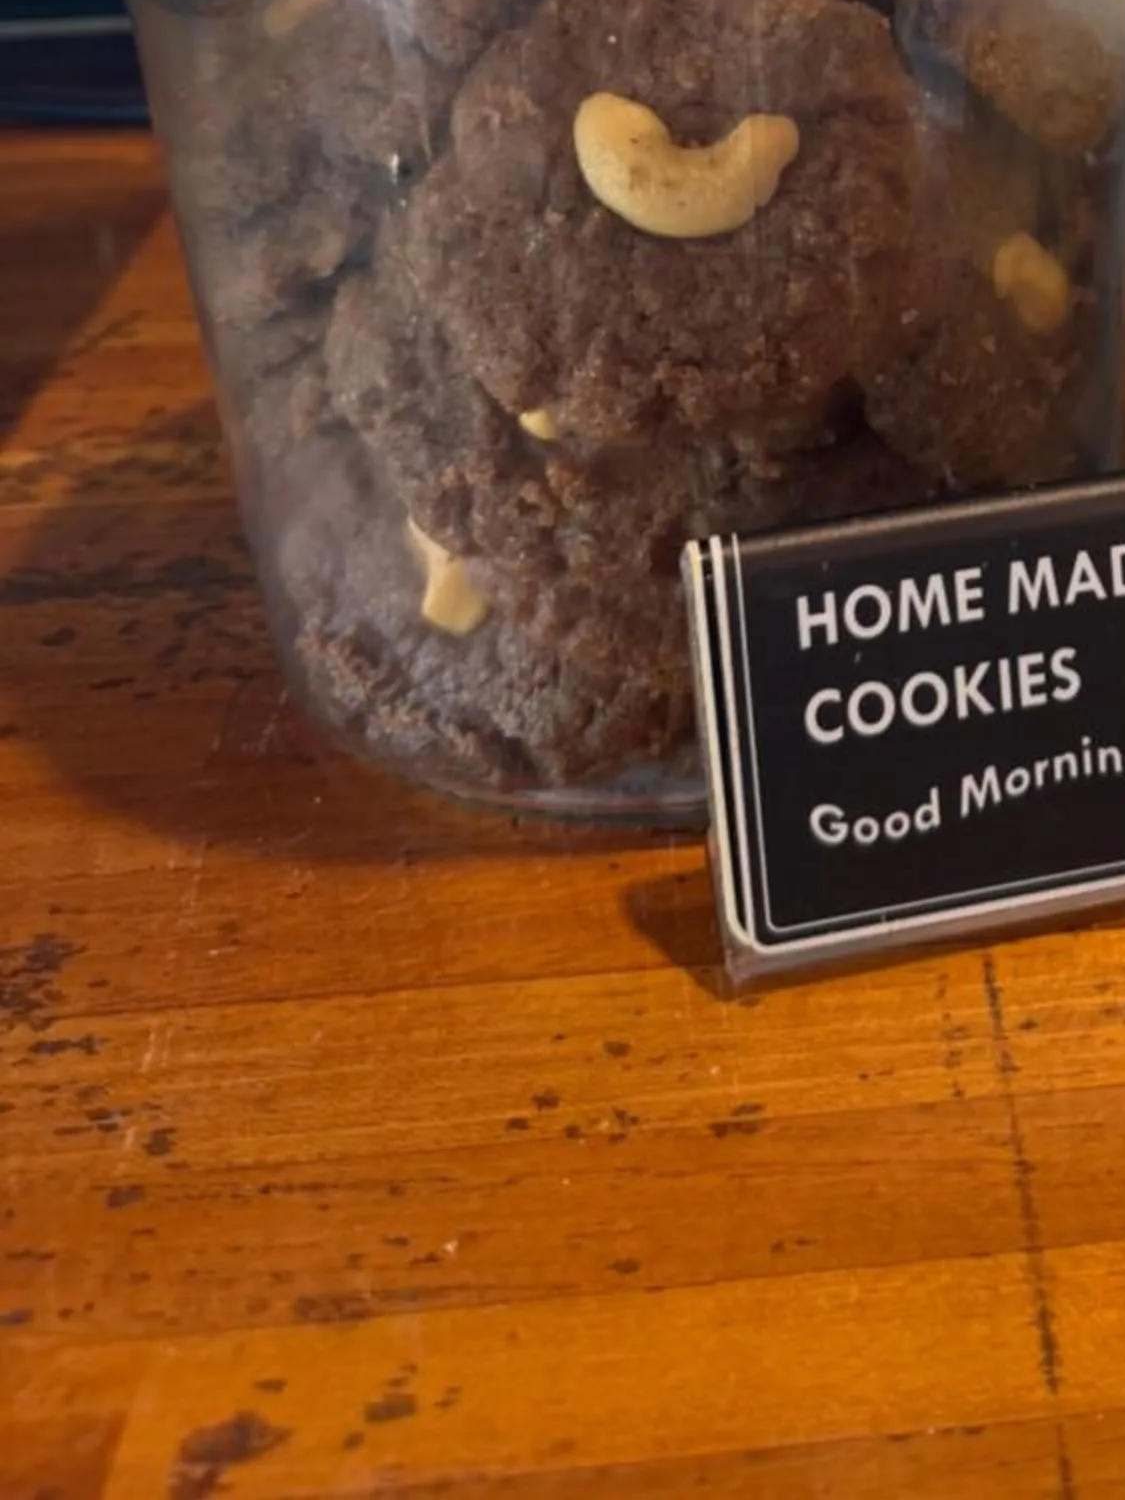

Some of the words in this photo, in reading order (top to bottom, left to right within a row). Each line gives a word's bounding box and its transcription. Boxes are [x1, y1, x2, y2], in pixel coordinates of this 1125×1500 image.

[796, 567, 985, 650] HOME
[804, 647, 1081, 744] COOKIES
[809, 787, 941, 845] Good
